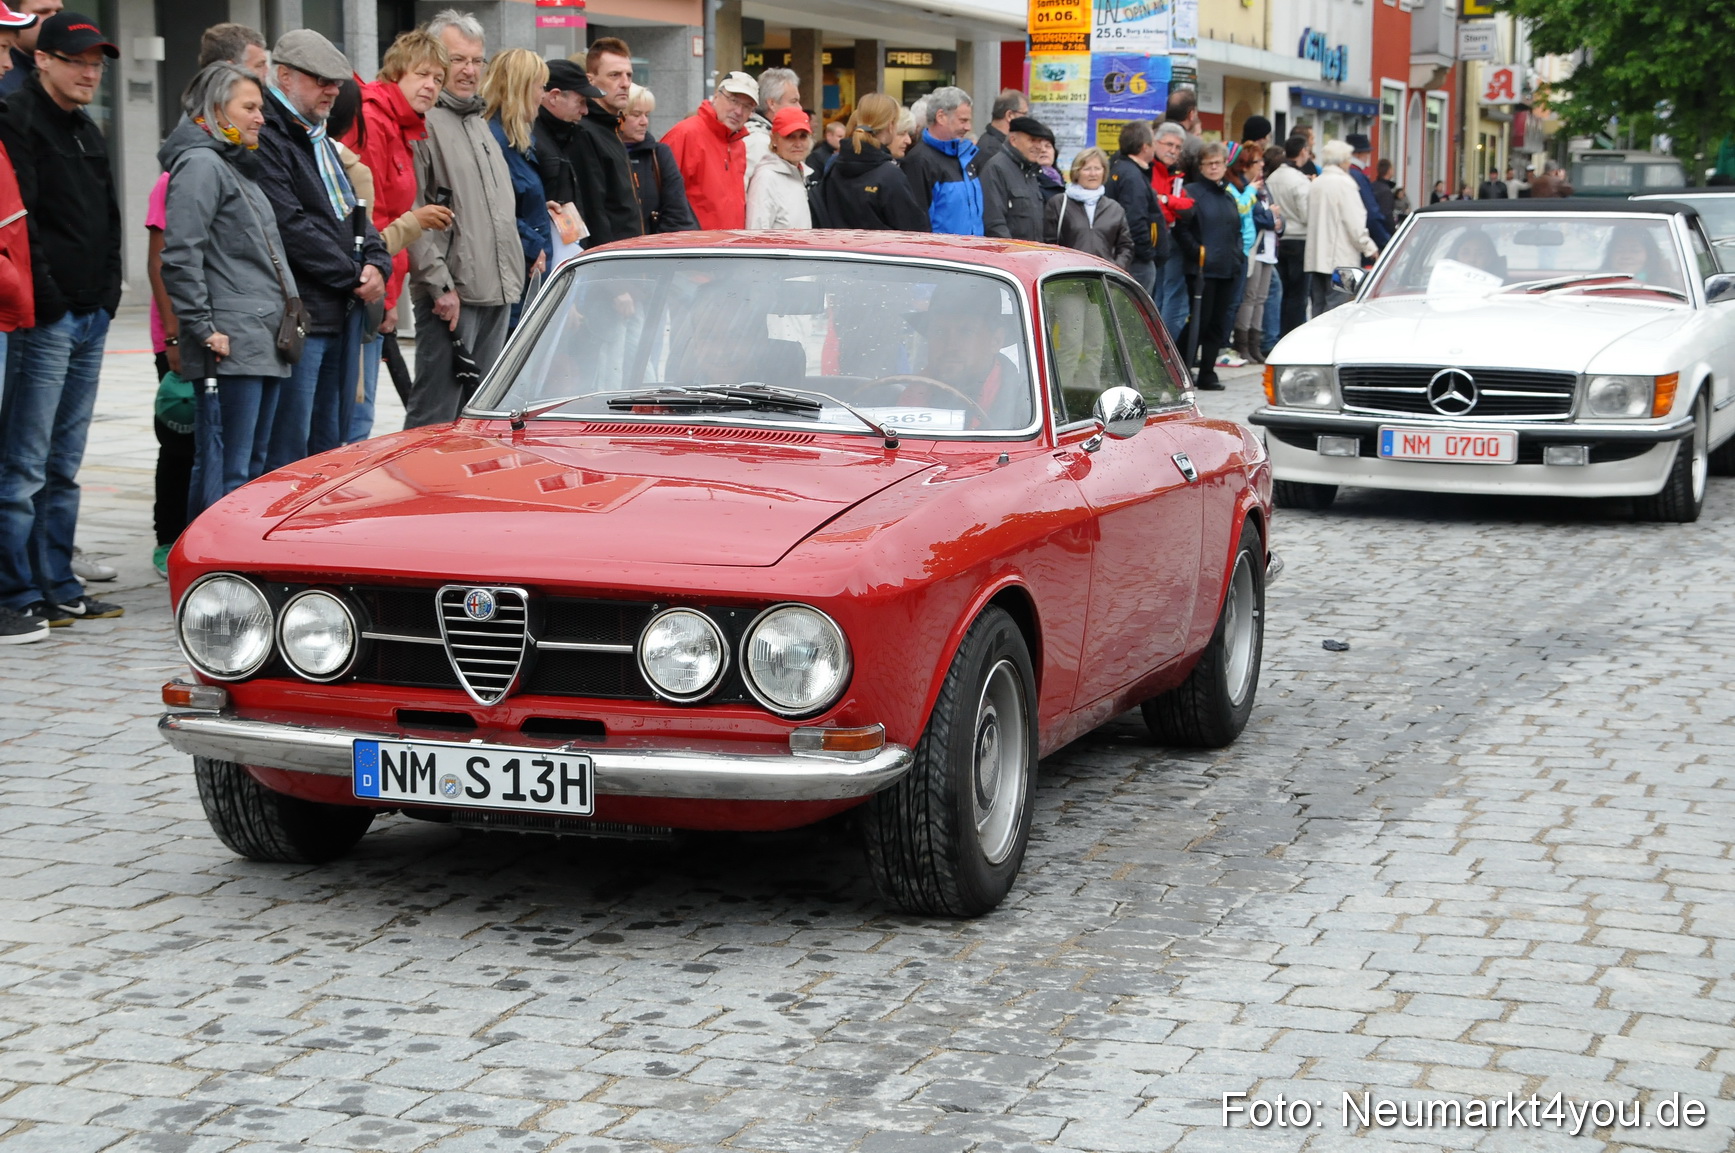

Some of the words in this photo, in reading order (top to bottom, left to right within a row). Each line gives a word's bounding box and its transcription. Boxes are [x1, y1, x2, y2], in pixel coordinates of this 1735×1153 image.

[1096, 27, 1126, 39] 25.6.
[887, 52, 933, 65] FRIES
[885, 412, 933, 424] 365
[1403, 434, 1431, 455] NM
[1445, 436, 1500, 457] 0700
[362, 774, 372, 787] D
[381, 749, 436, 795] NM
[465, 756, 491, 799] S
